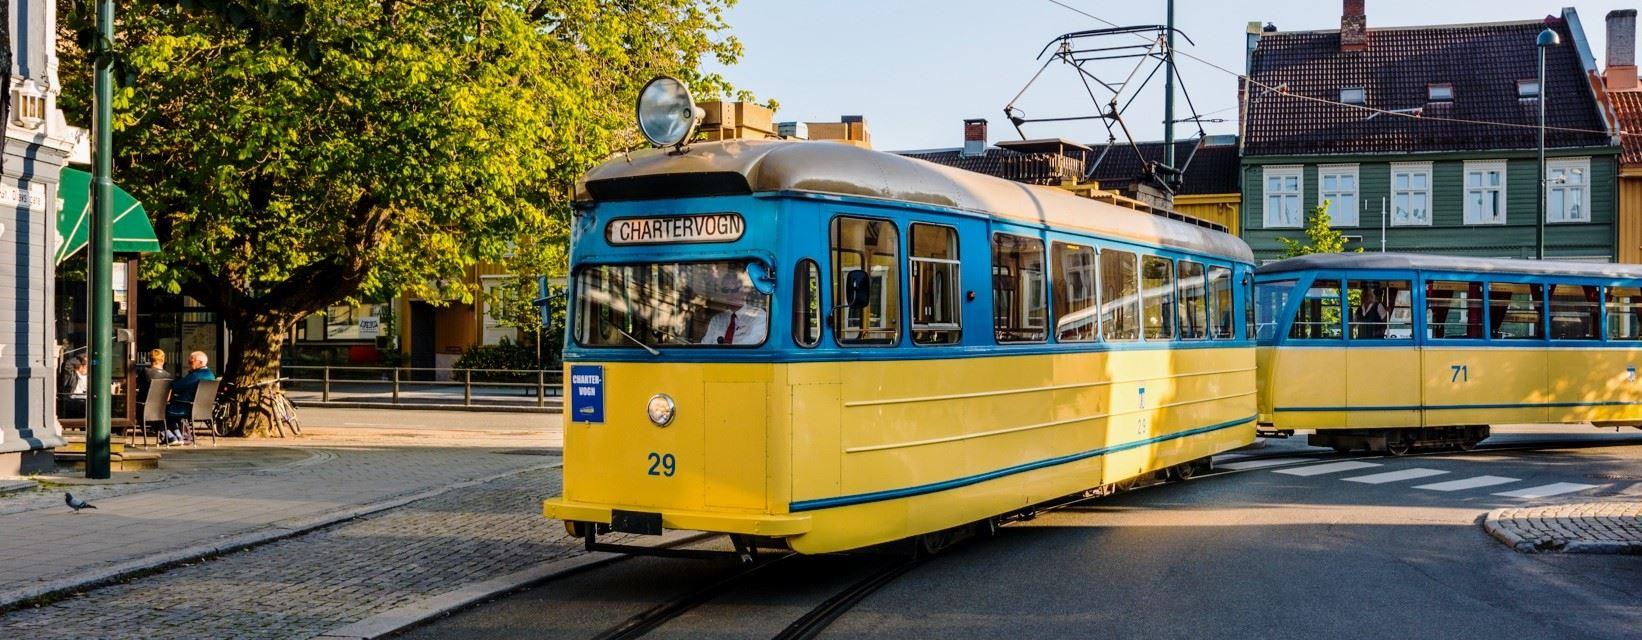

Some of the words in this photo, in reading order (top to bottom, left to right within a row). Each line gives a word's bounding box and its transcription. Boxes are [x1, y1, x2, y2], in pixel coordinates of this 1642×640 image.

[620, 215, 740, 241] CHARTERVOGN
[572, 375, 602, 384] CHARTER-
[1451, 365, 1467, 382] 71
[579, 386, 596, 396] VOGN
[648, 452, 676, 477] 29
